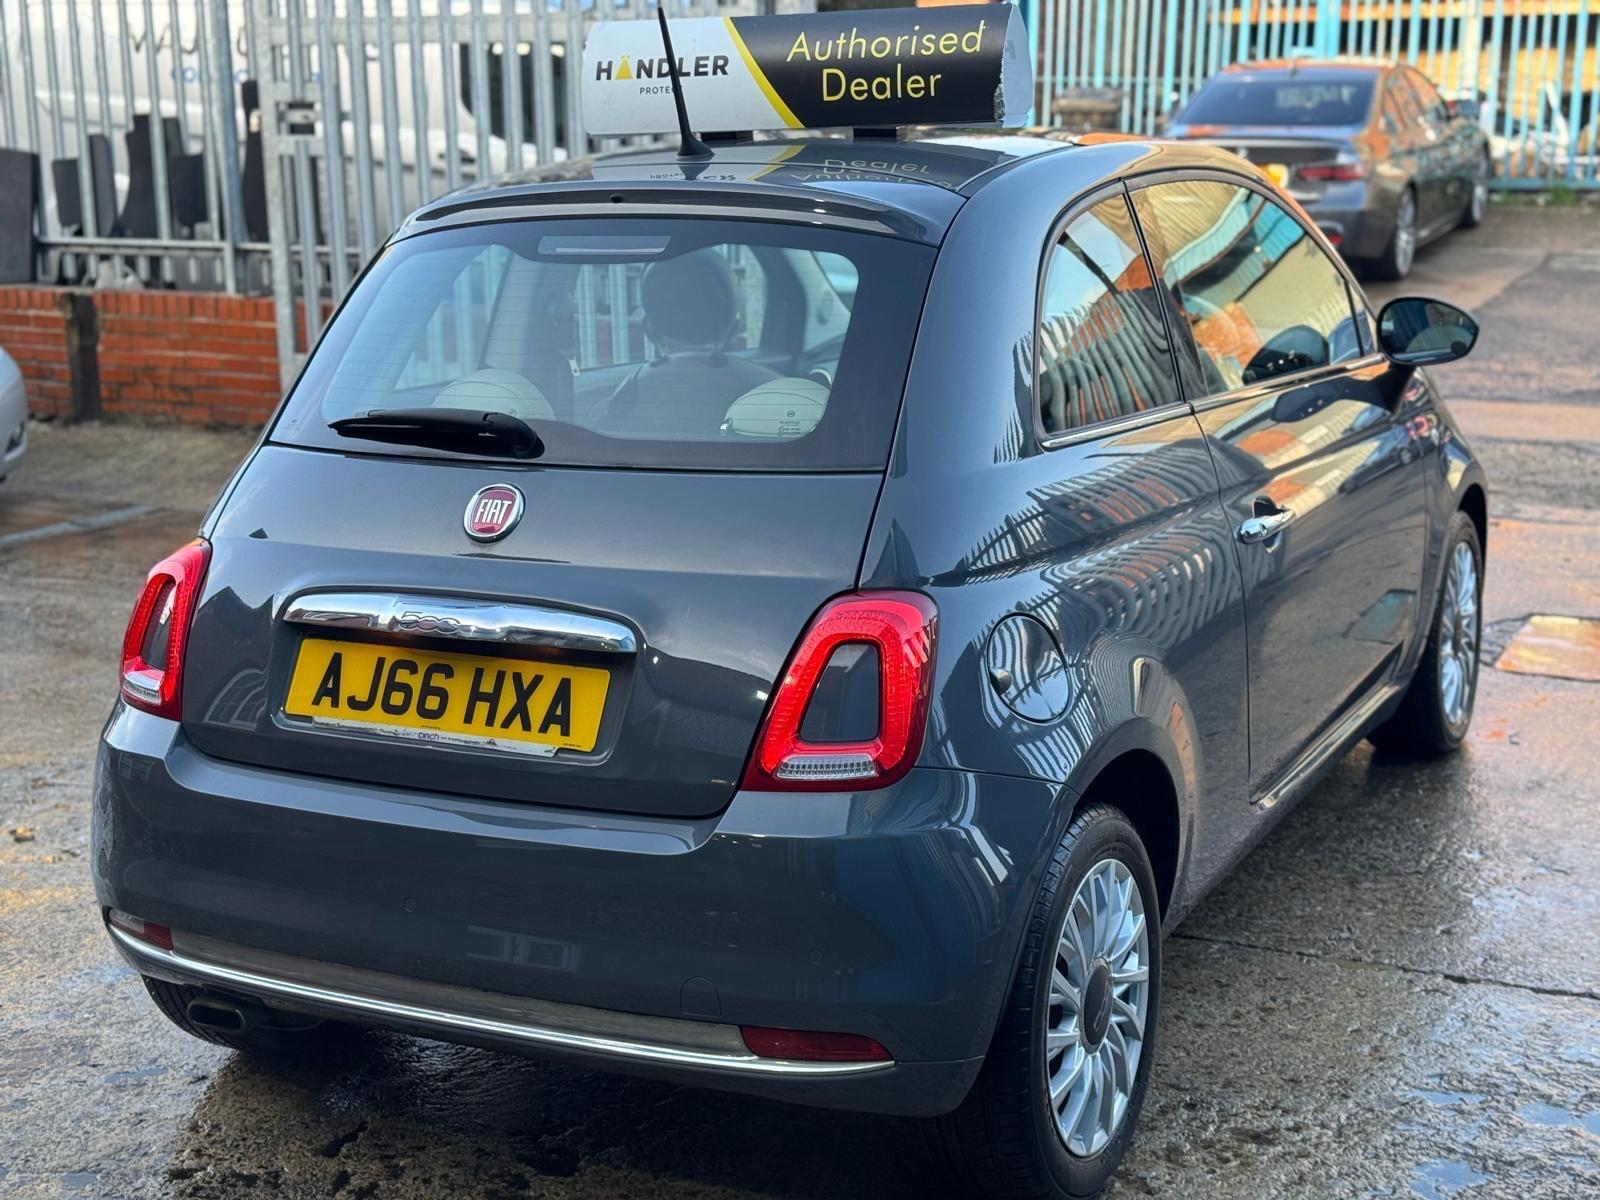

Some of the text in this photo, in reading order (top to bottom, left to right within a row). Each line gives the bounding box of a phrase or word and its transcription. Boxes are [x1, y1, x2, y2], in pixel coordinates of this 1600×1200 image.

[786, 19, 986, 62] Authorised
[639, 85, 684, 95] PROTE
[821, 62, 943, 103] Dealer
[474, 498, 513, 525] FIAT
[397, 610, 461, 635] 500
[311, 651, 573, 737] AJ66 HXA
[417, 731, 441, 742] cinch
